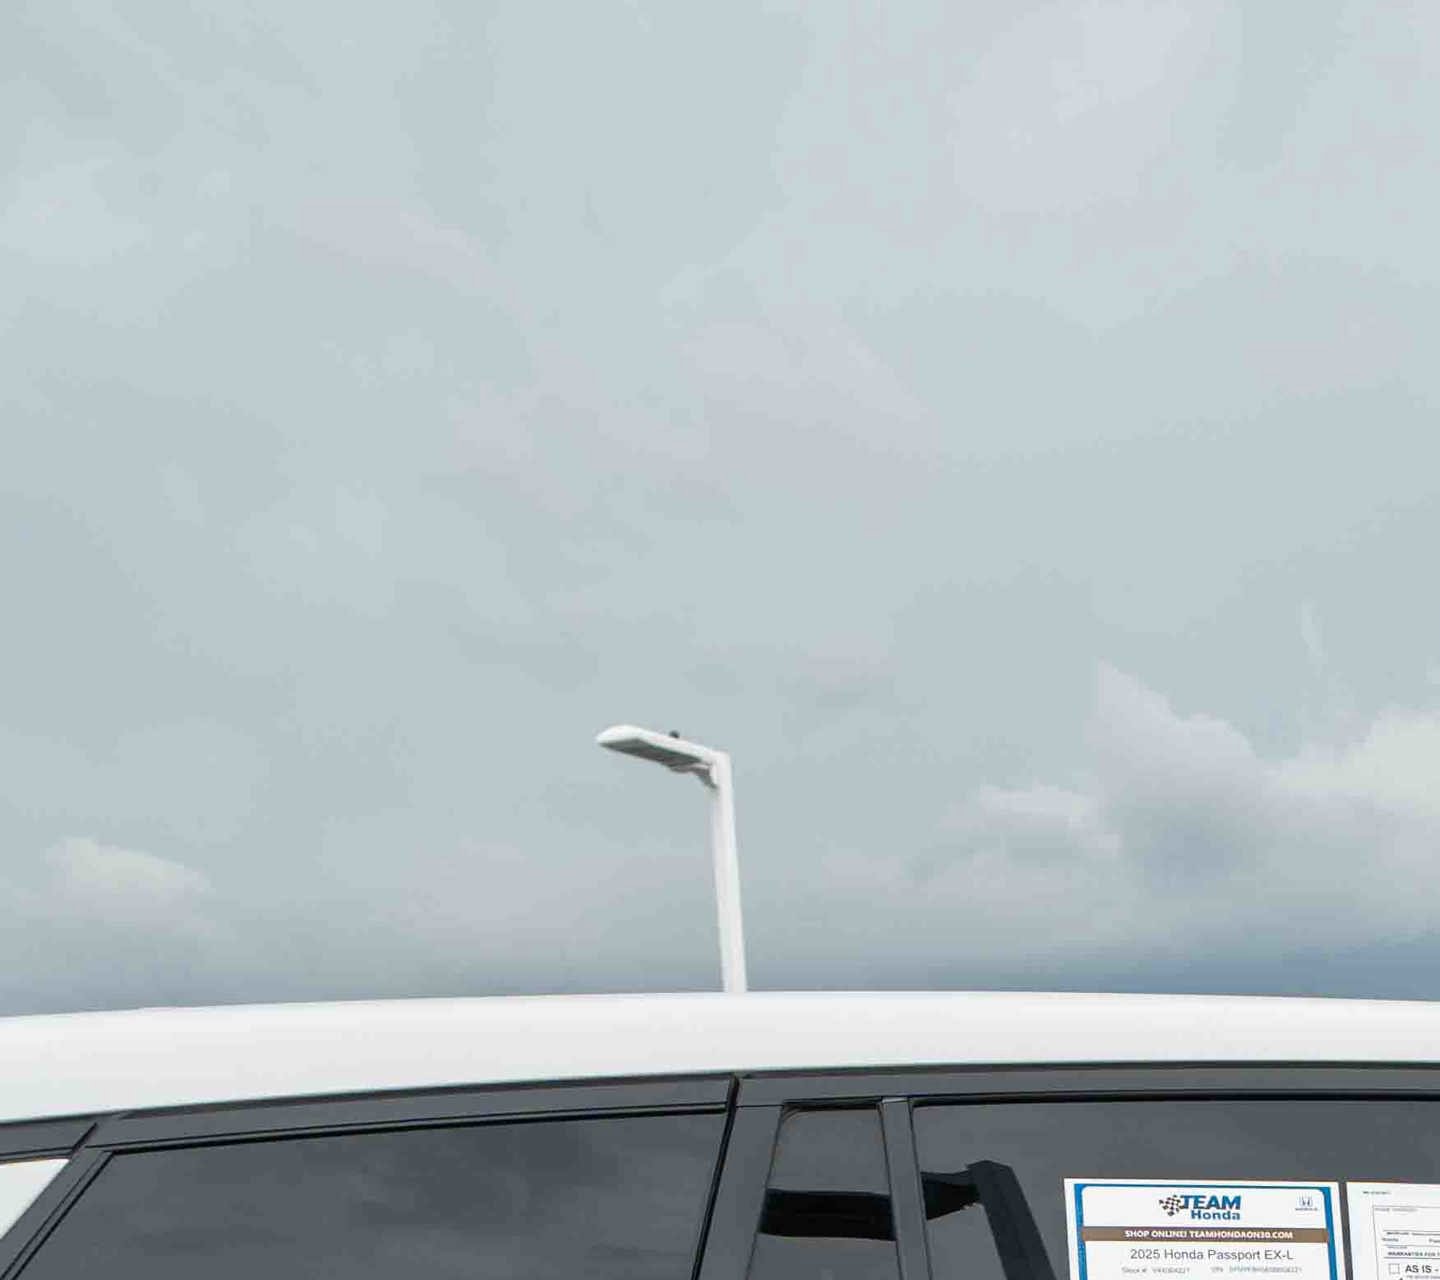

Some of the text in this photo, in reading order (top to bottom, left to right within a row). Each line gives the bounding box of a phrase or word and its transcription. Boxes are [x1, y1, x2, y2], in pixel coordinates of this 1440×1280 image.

[1180, 1195, 1241, 1210] TEAM
[1191, 1211, 1240, 1220] Honda
[1125, 1230, 1149, 1238] SHOP
[1130, 1249, 1294, 1263] 2025 Honda Passport EX-L
[1405, 1265, 1419, 1273] AS
[1422, 1265, 1432, 1273] IS
